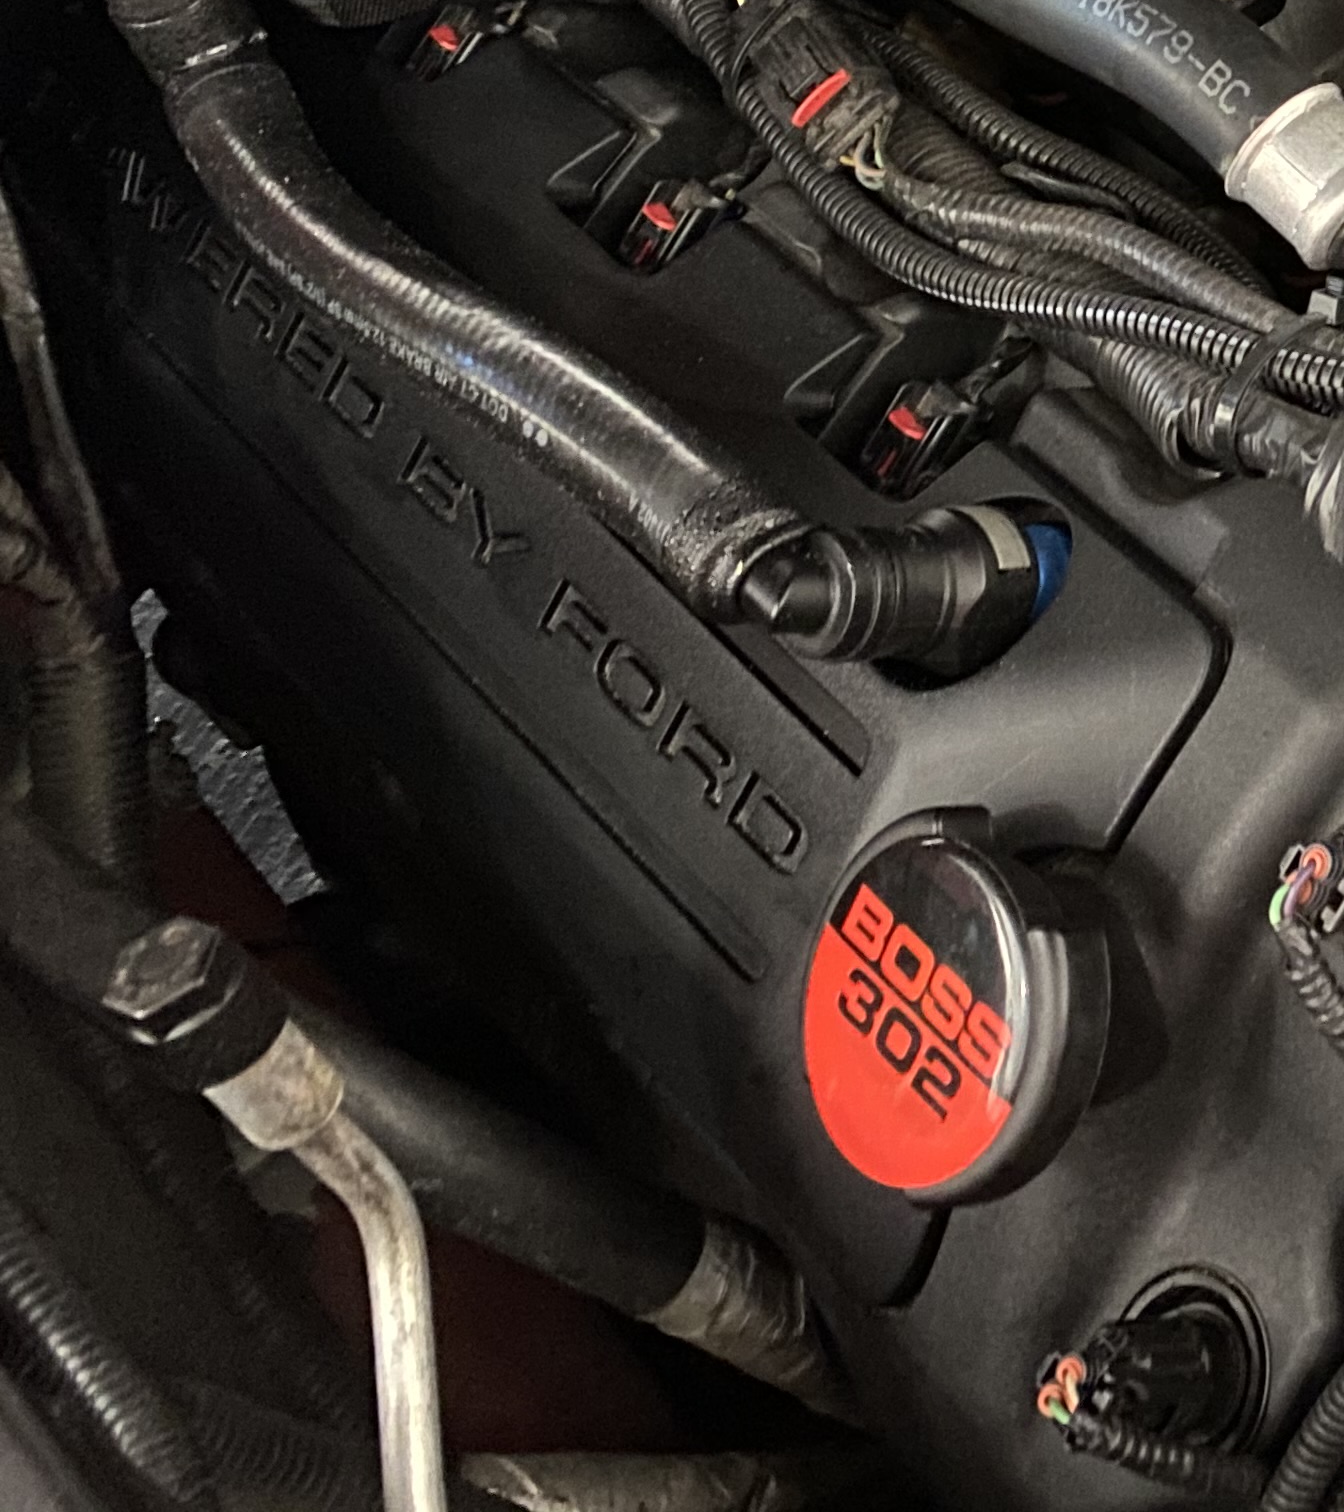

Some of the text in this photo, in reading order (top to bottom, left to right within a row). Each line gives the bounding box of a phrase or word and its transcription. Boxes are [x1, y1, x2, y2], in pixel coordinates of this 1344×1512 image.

[400, 437, 530, 566] BY
[537, 580, 811, 876] FORD
[837, 967, 962, 1123] 302
[842, 883, 1012, 1081] BOSS
